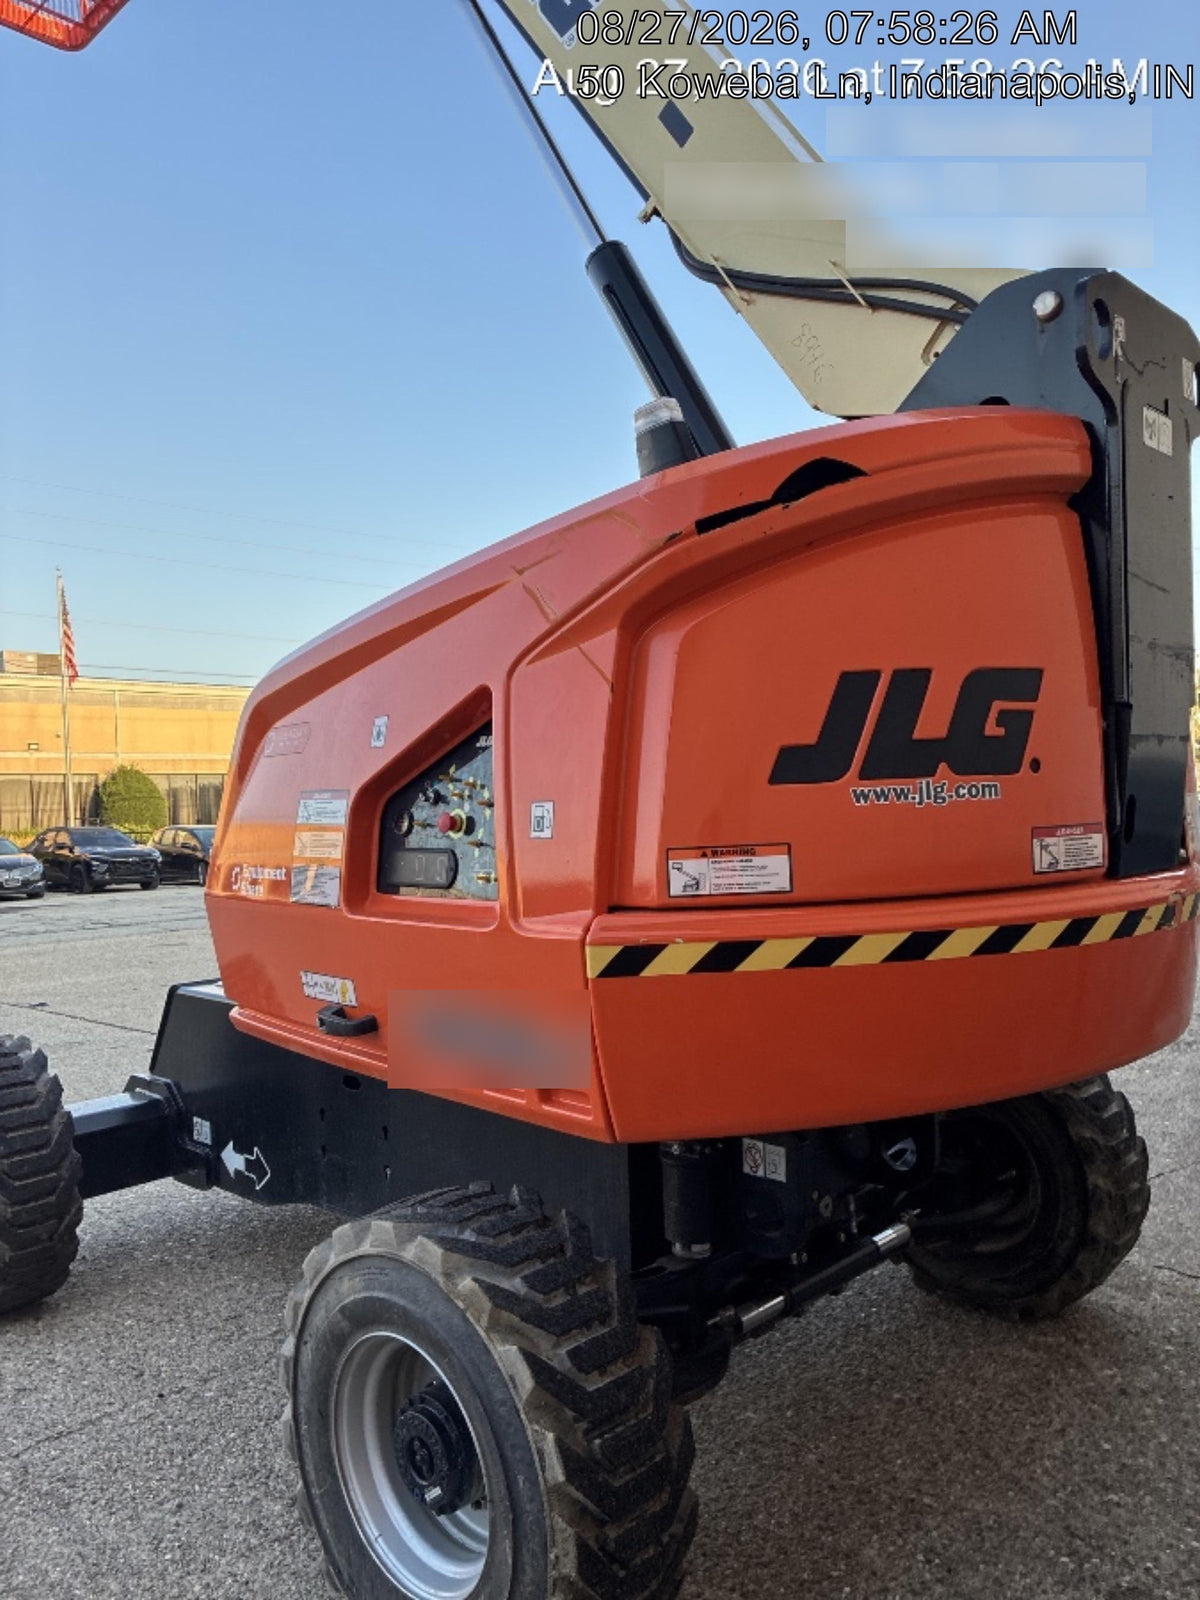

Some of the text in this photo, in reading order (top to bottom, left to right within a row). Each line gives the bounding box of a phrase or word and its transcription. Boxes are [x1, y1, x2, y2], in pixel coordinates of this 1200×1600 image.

[768, 667, 1044, 785] JLG
[852, 780, 1000, 807] www.jlg.com
[711, 848, 756, 858] WARNING
